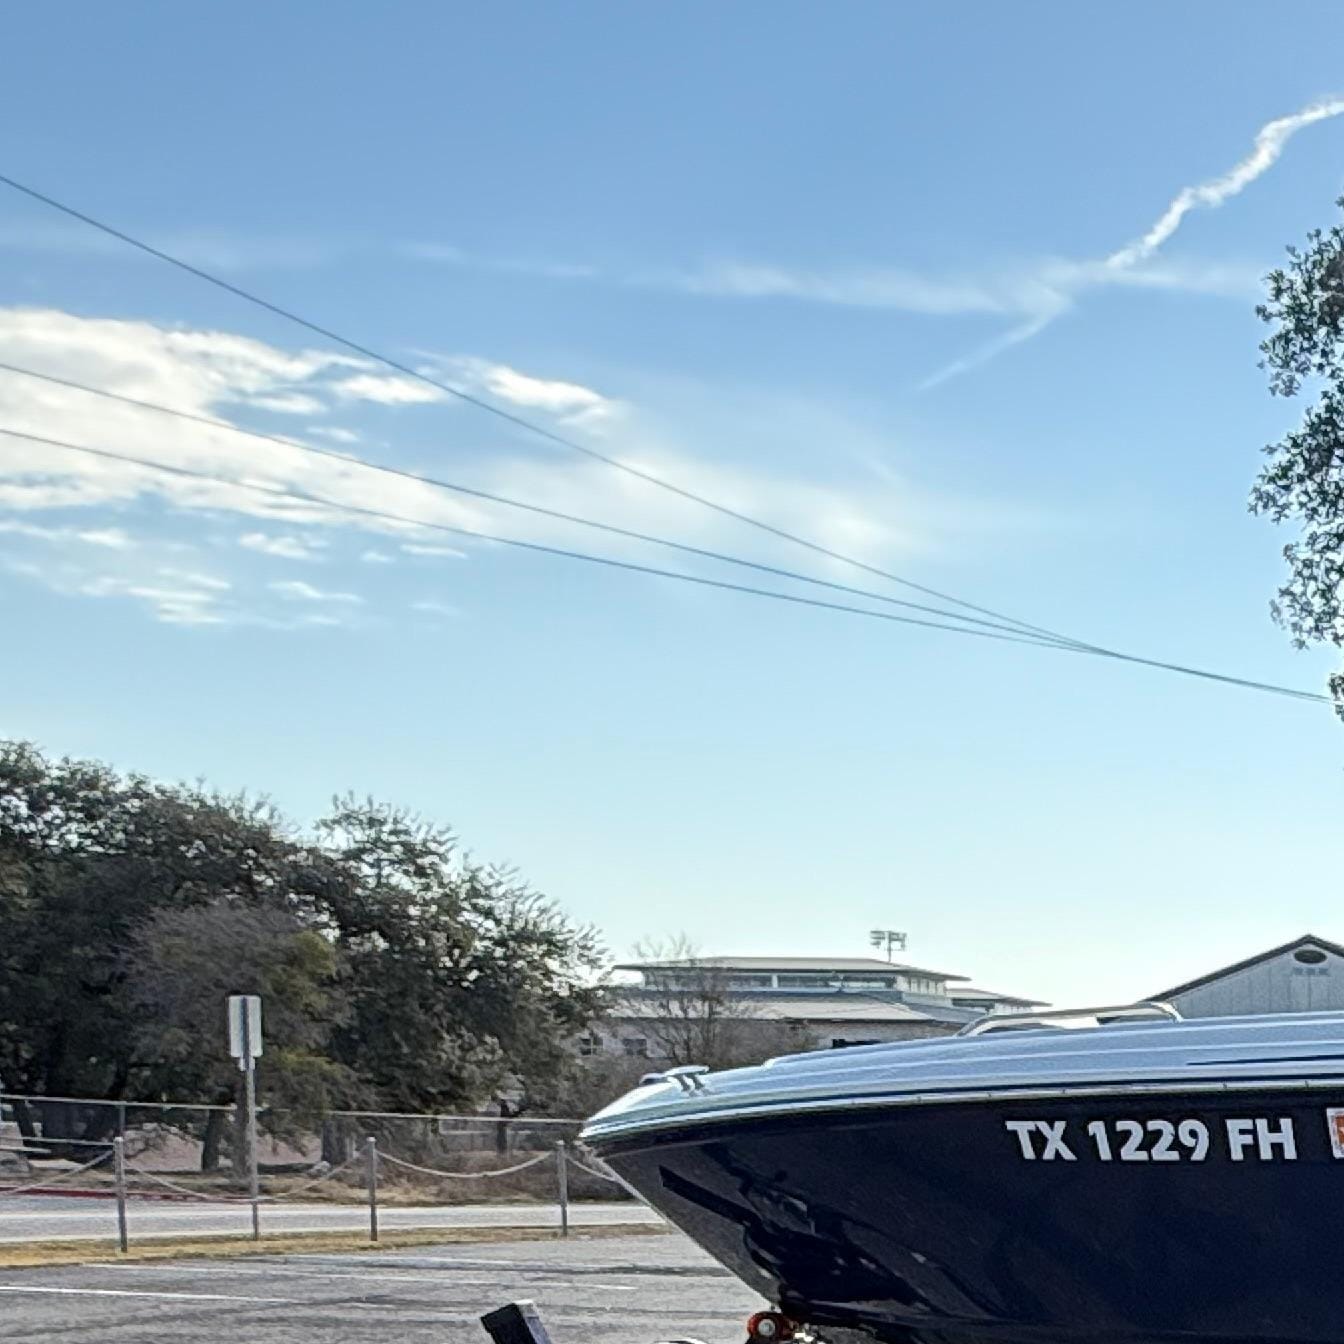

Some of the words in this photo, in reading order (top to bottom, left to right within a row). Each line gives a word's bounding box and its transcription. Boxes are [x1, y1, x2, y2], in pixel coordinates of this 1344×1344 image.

[1005, 1119, 1078, 1161] TX
[1087, 1119, 1211, 1162] 1229
[1225, 1117, 1298, 1161] FH
